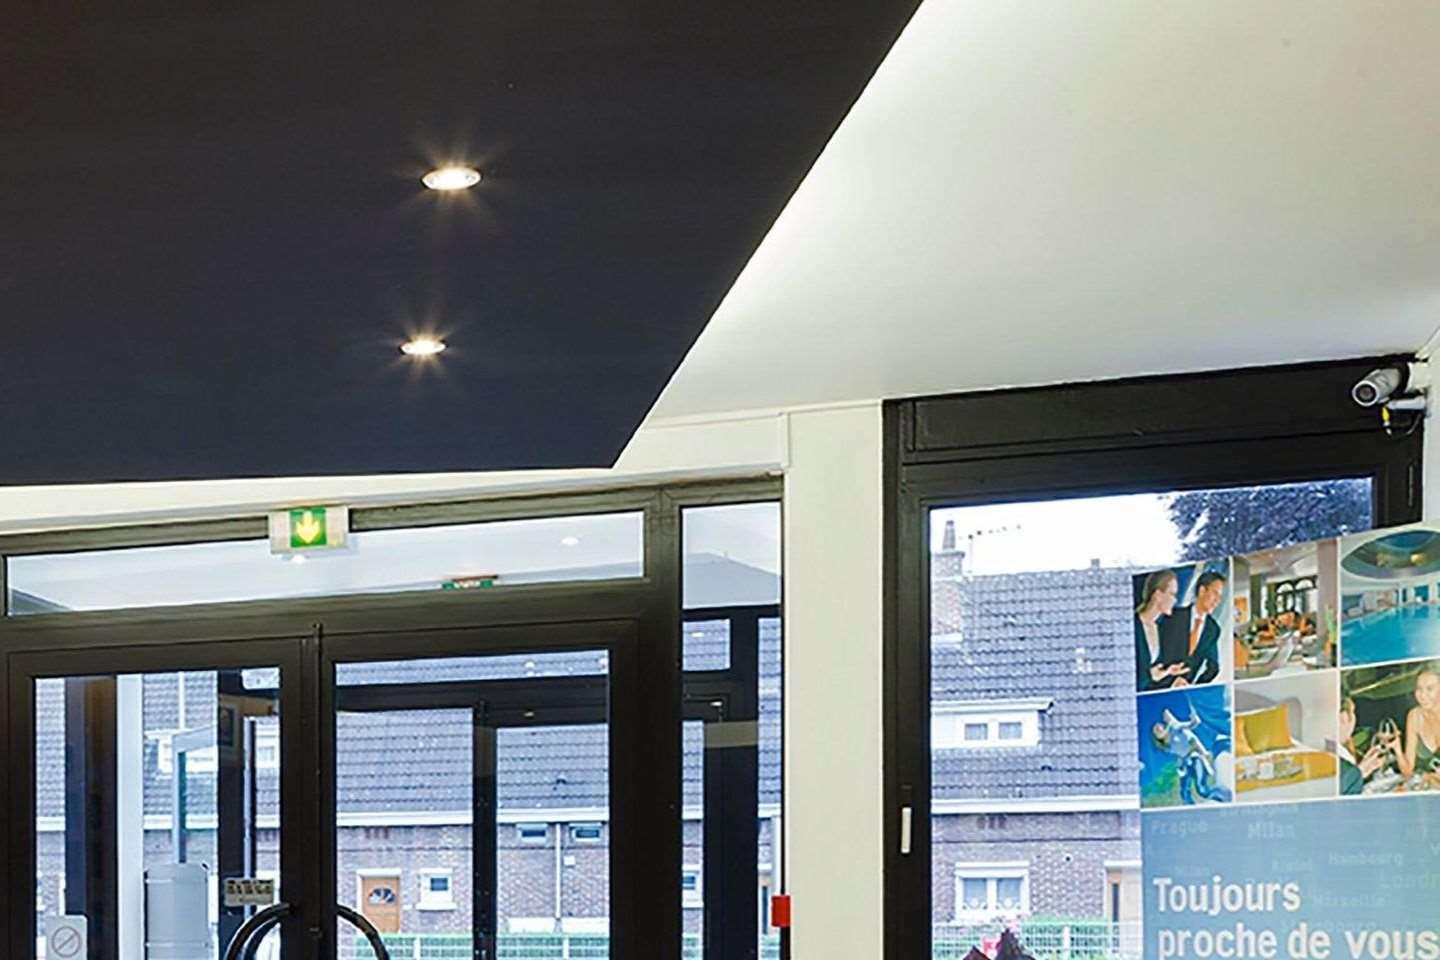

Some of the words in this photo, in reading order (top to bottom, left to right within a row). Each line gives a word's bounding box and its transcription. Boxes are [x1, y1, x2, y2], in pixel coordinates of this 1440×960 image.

[1153, 875, 1301, 915] Toujours
[1288, 923, 1331, 959] de
[1345, 930, 1440, 960] vous
